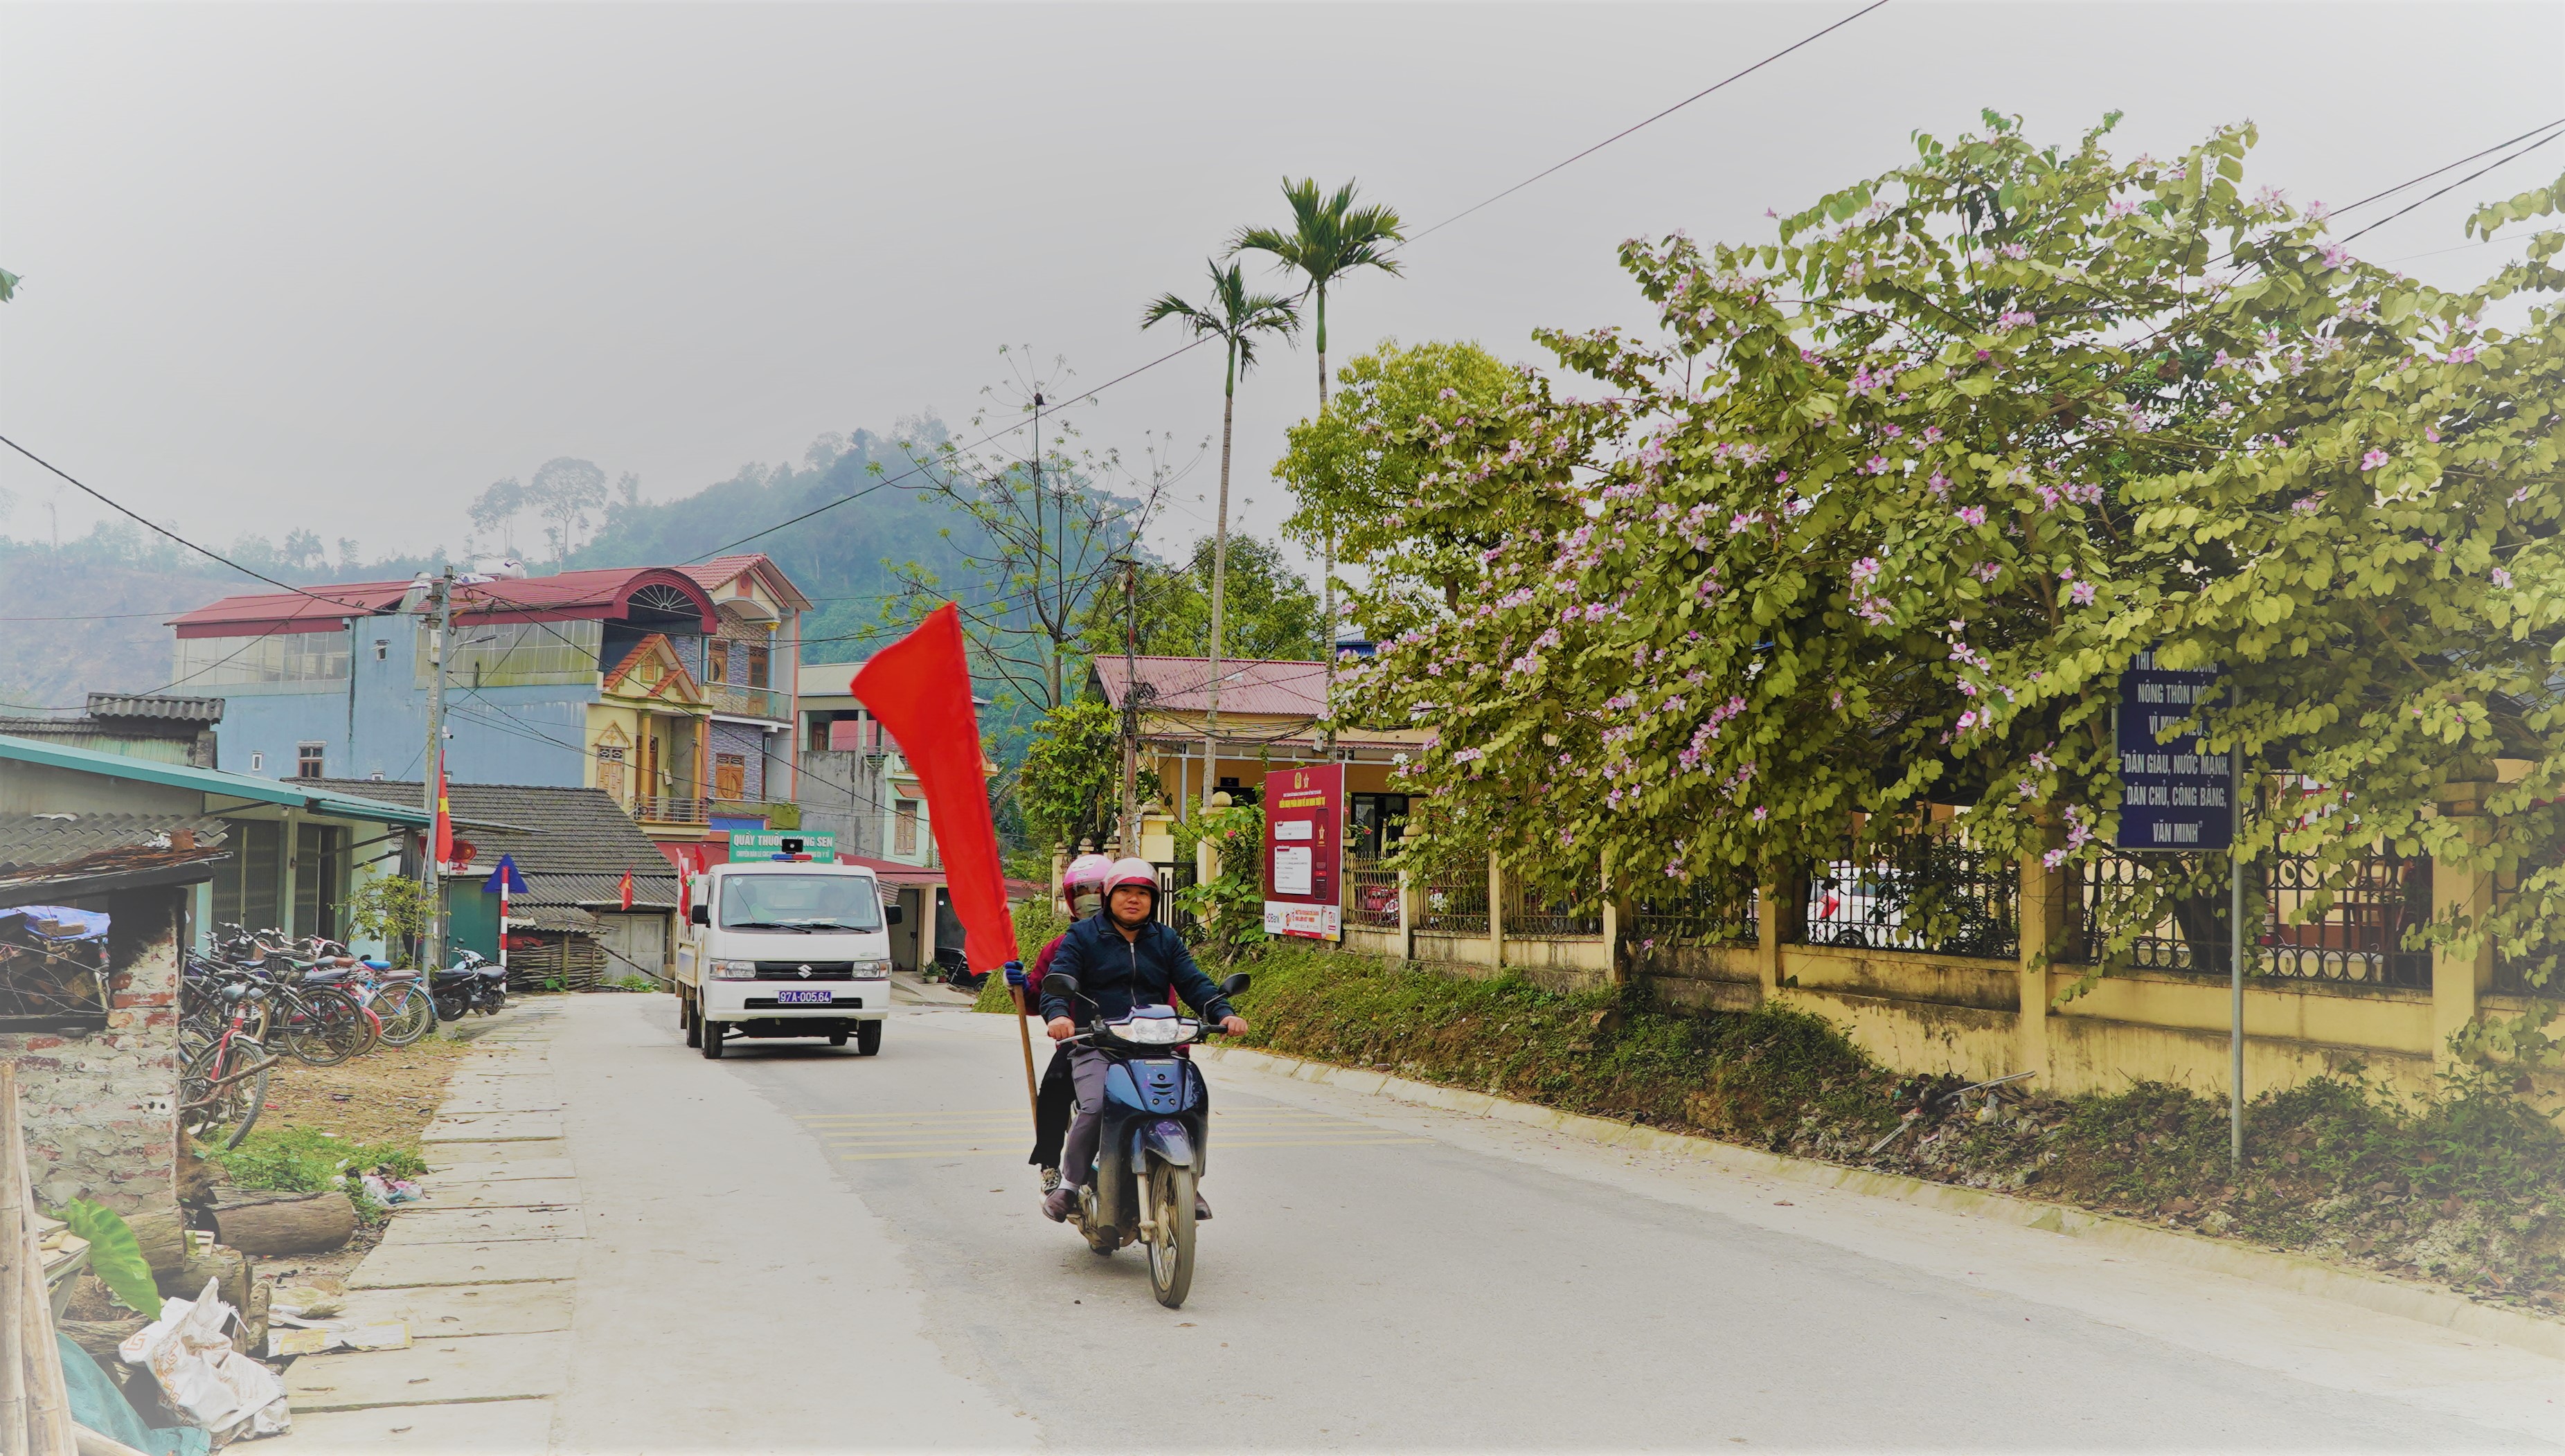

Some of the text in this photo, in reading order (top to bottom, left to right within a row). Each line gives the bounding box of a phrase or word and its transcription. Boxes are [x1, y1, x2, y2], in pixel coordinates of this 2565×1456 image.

[2138, 679, 2210, 705] NÔNG THÔN MỚ
[2149, 711, 2158, 735] VÌ
[2147, 750, 2171, 776] GIÀU,
[2173, 749, 2198, 775] NƯỚC
[2201, 755, 2230, 779] MẠNH,
[2127, 779, 2226, 809] DÂN CHỦ, CÔNG BẰNG,
[733, 830, 755, 847] QUẦY
[817, 836, 832, 847] SEN
[2153, 819, 2172, 843] VĂN
[780, 991, 830, 1003] 97A-005.64
